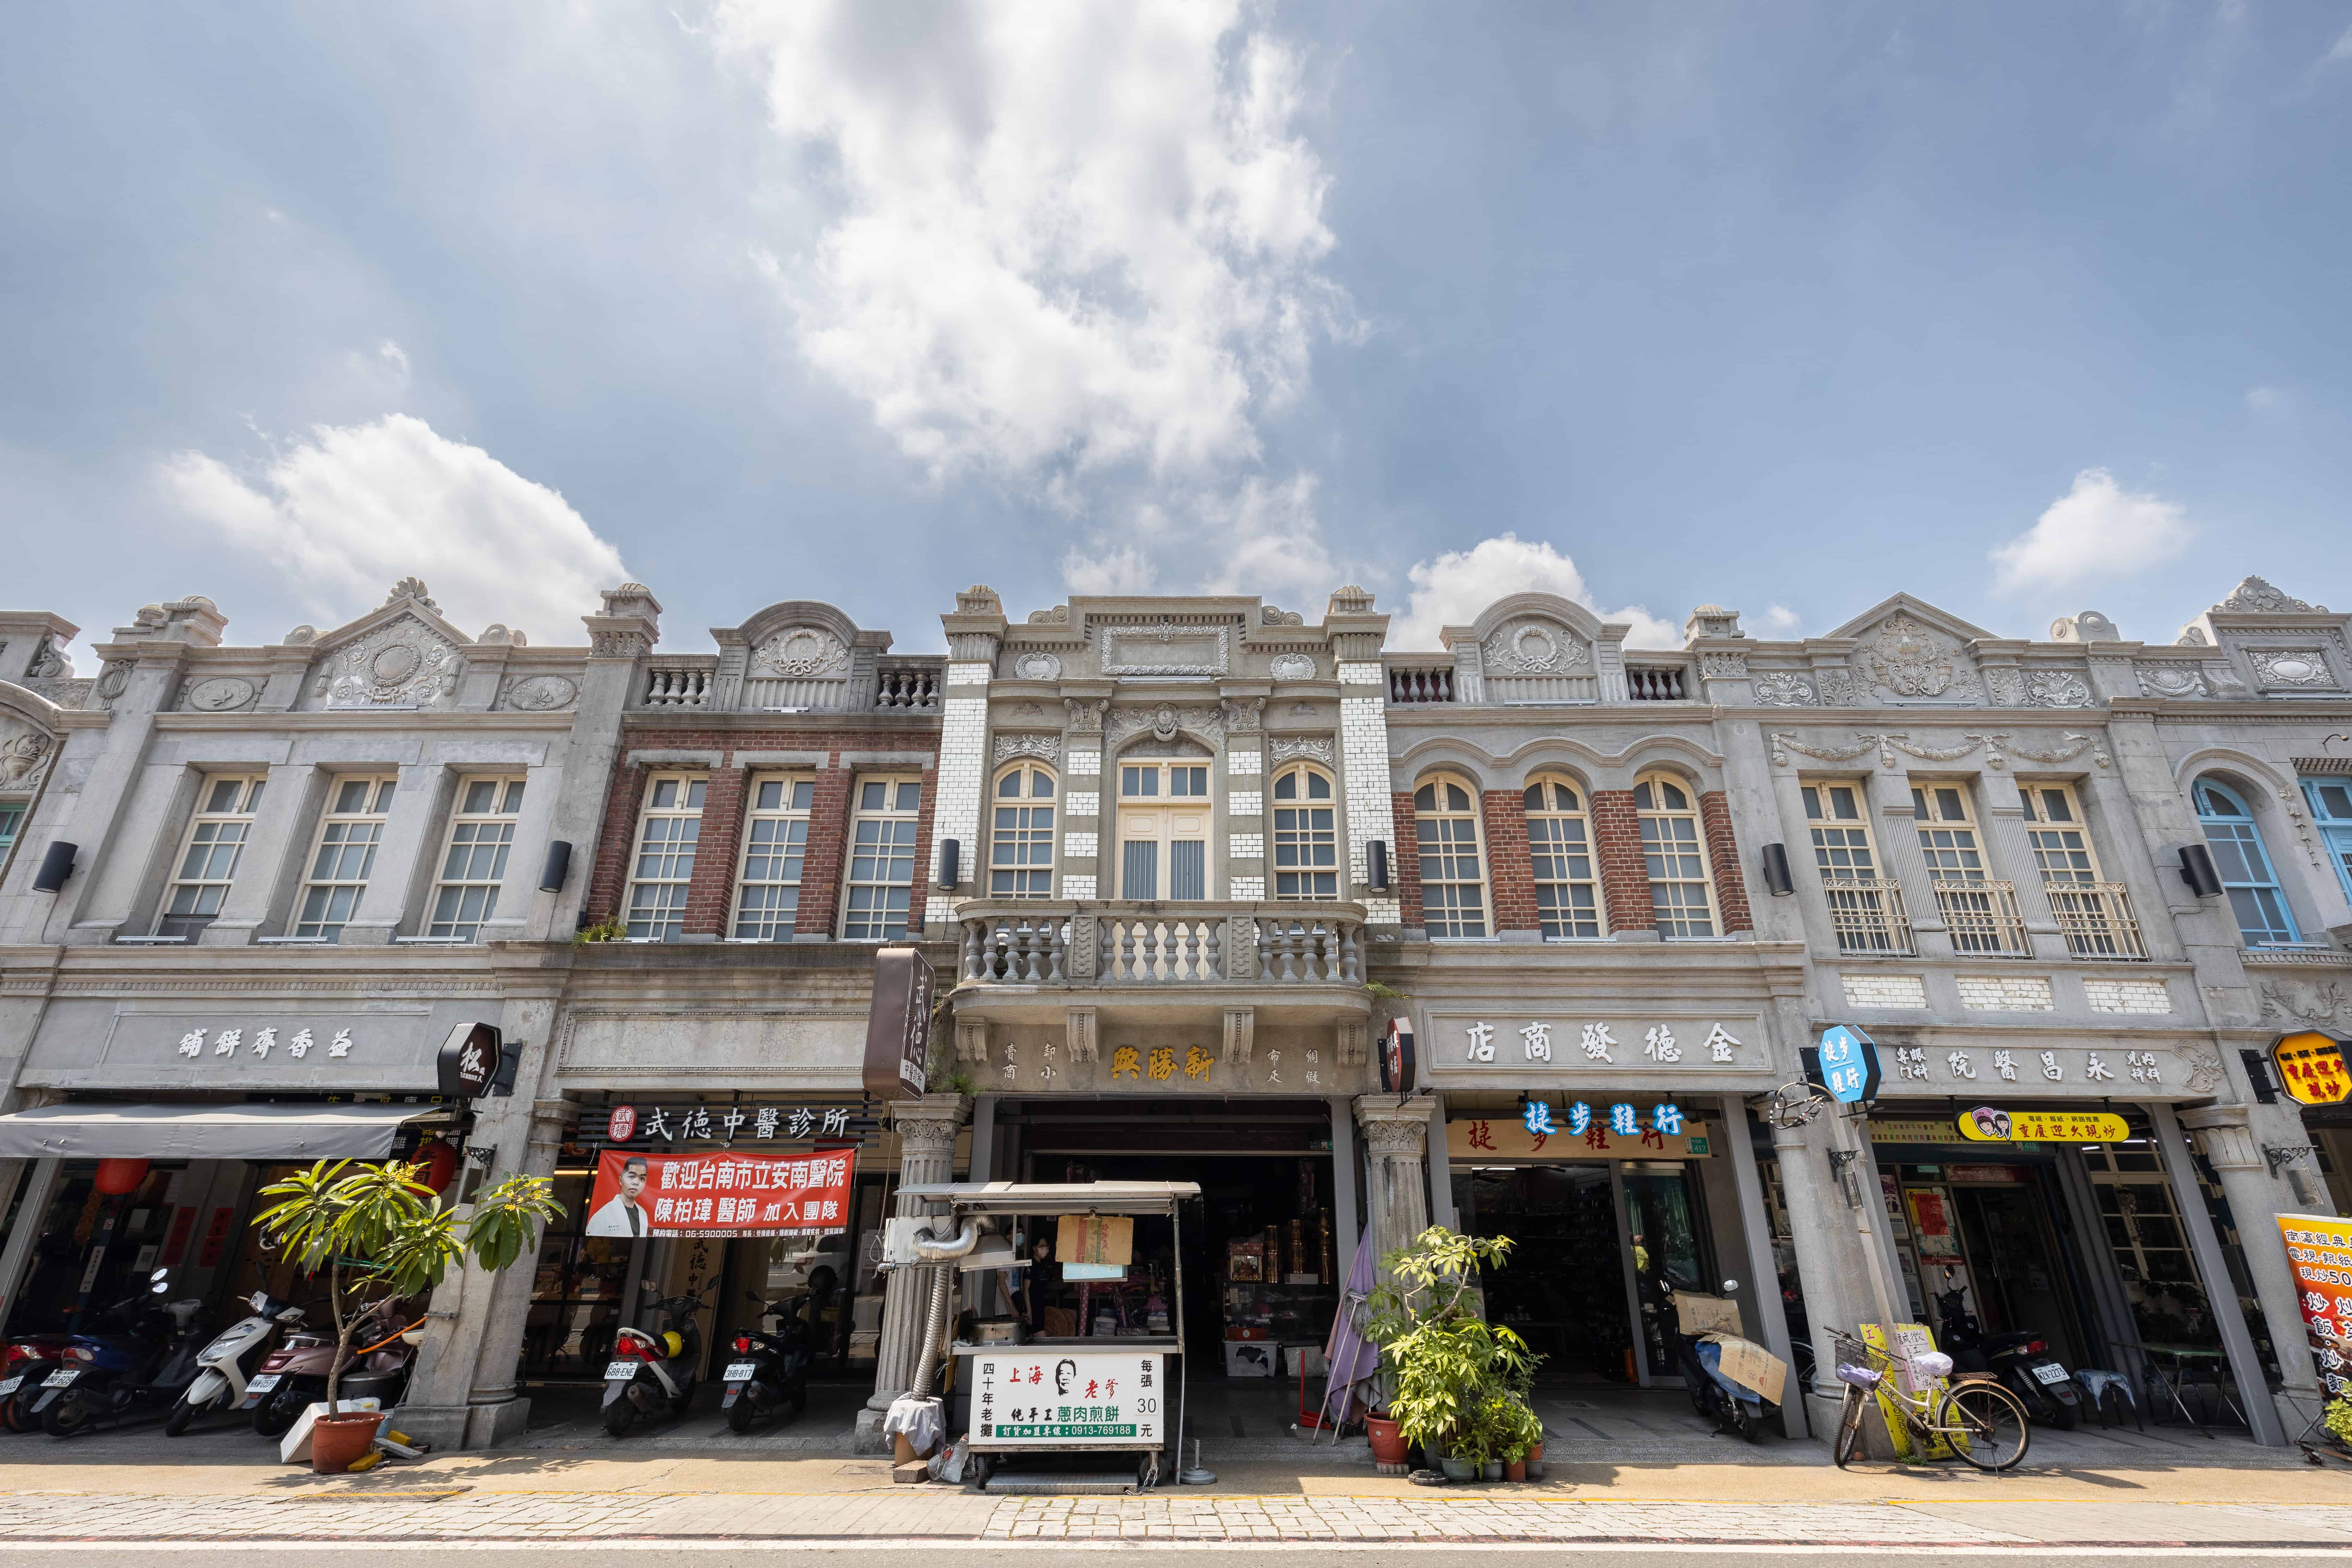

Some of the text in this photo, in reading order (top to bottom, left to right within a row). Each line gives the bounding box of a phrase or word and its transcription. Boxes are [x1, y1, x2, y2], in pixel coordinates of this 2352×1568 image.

[1466, 1021, 1742, 1063] 金德發商店
[905, 1061, 922, 1089] 中醫診所
[1111, 1046, 1214, 1082] 新勝興
[1948, 1050, 2114, 1081] 永昌醫院
[646, 1107, 849, 1140] 武德中醫診所
[1525, 1102, 1683, 1135] 捷步鞋行
[661, 1159, 846, 1191] 歡迎台南市立安南醫院
[654, 1197, 838, 1223] 陳柏瑋 醫師 加入團隊
[607, 1368, 636, 1376] 688-ENE
[1009, 1365, 1043, 1385] 上海
[980, 1363, 994, 1437] 四十年老攤
[1137, 1398, 1156, 1413] 30
[1141, 1424, 1153, 1437] 元
